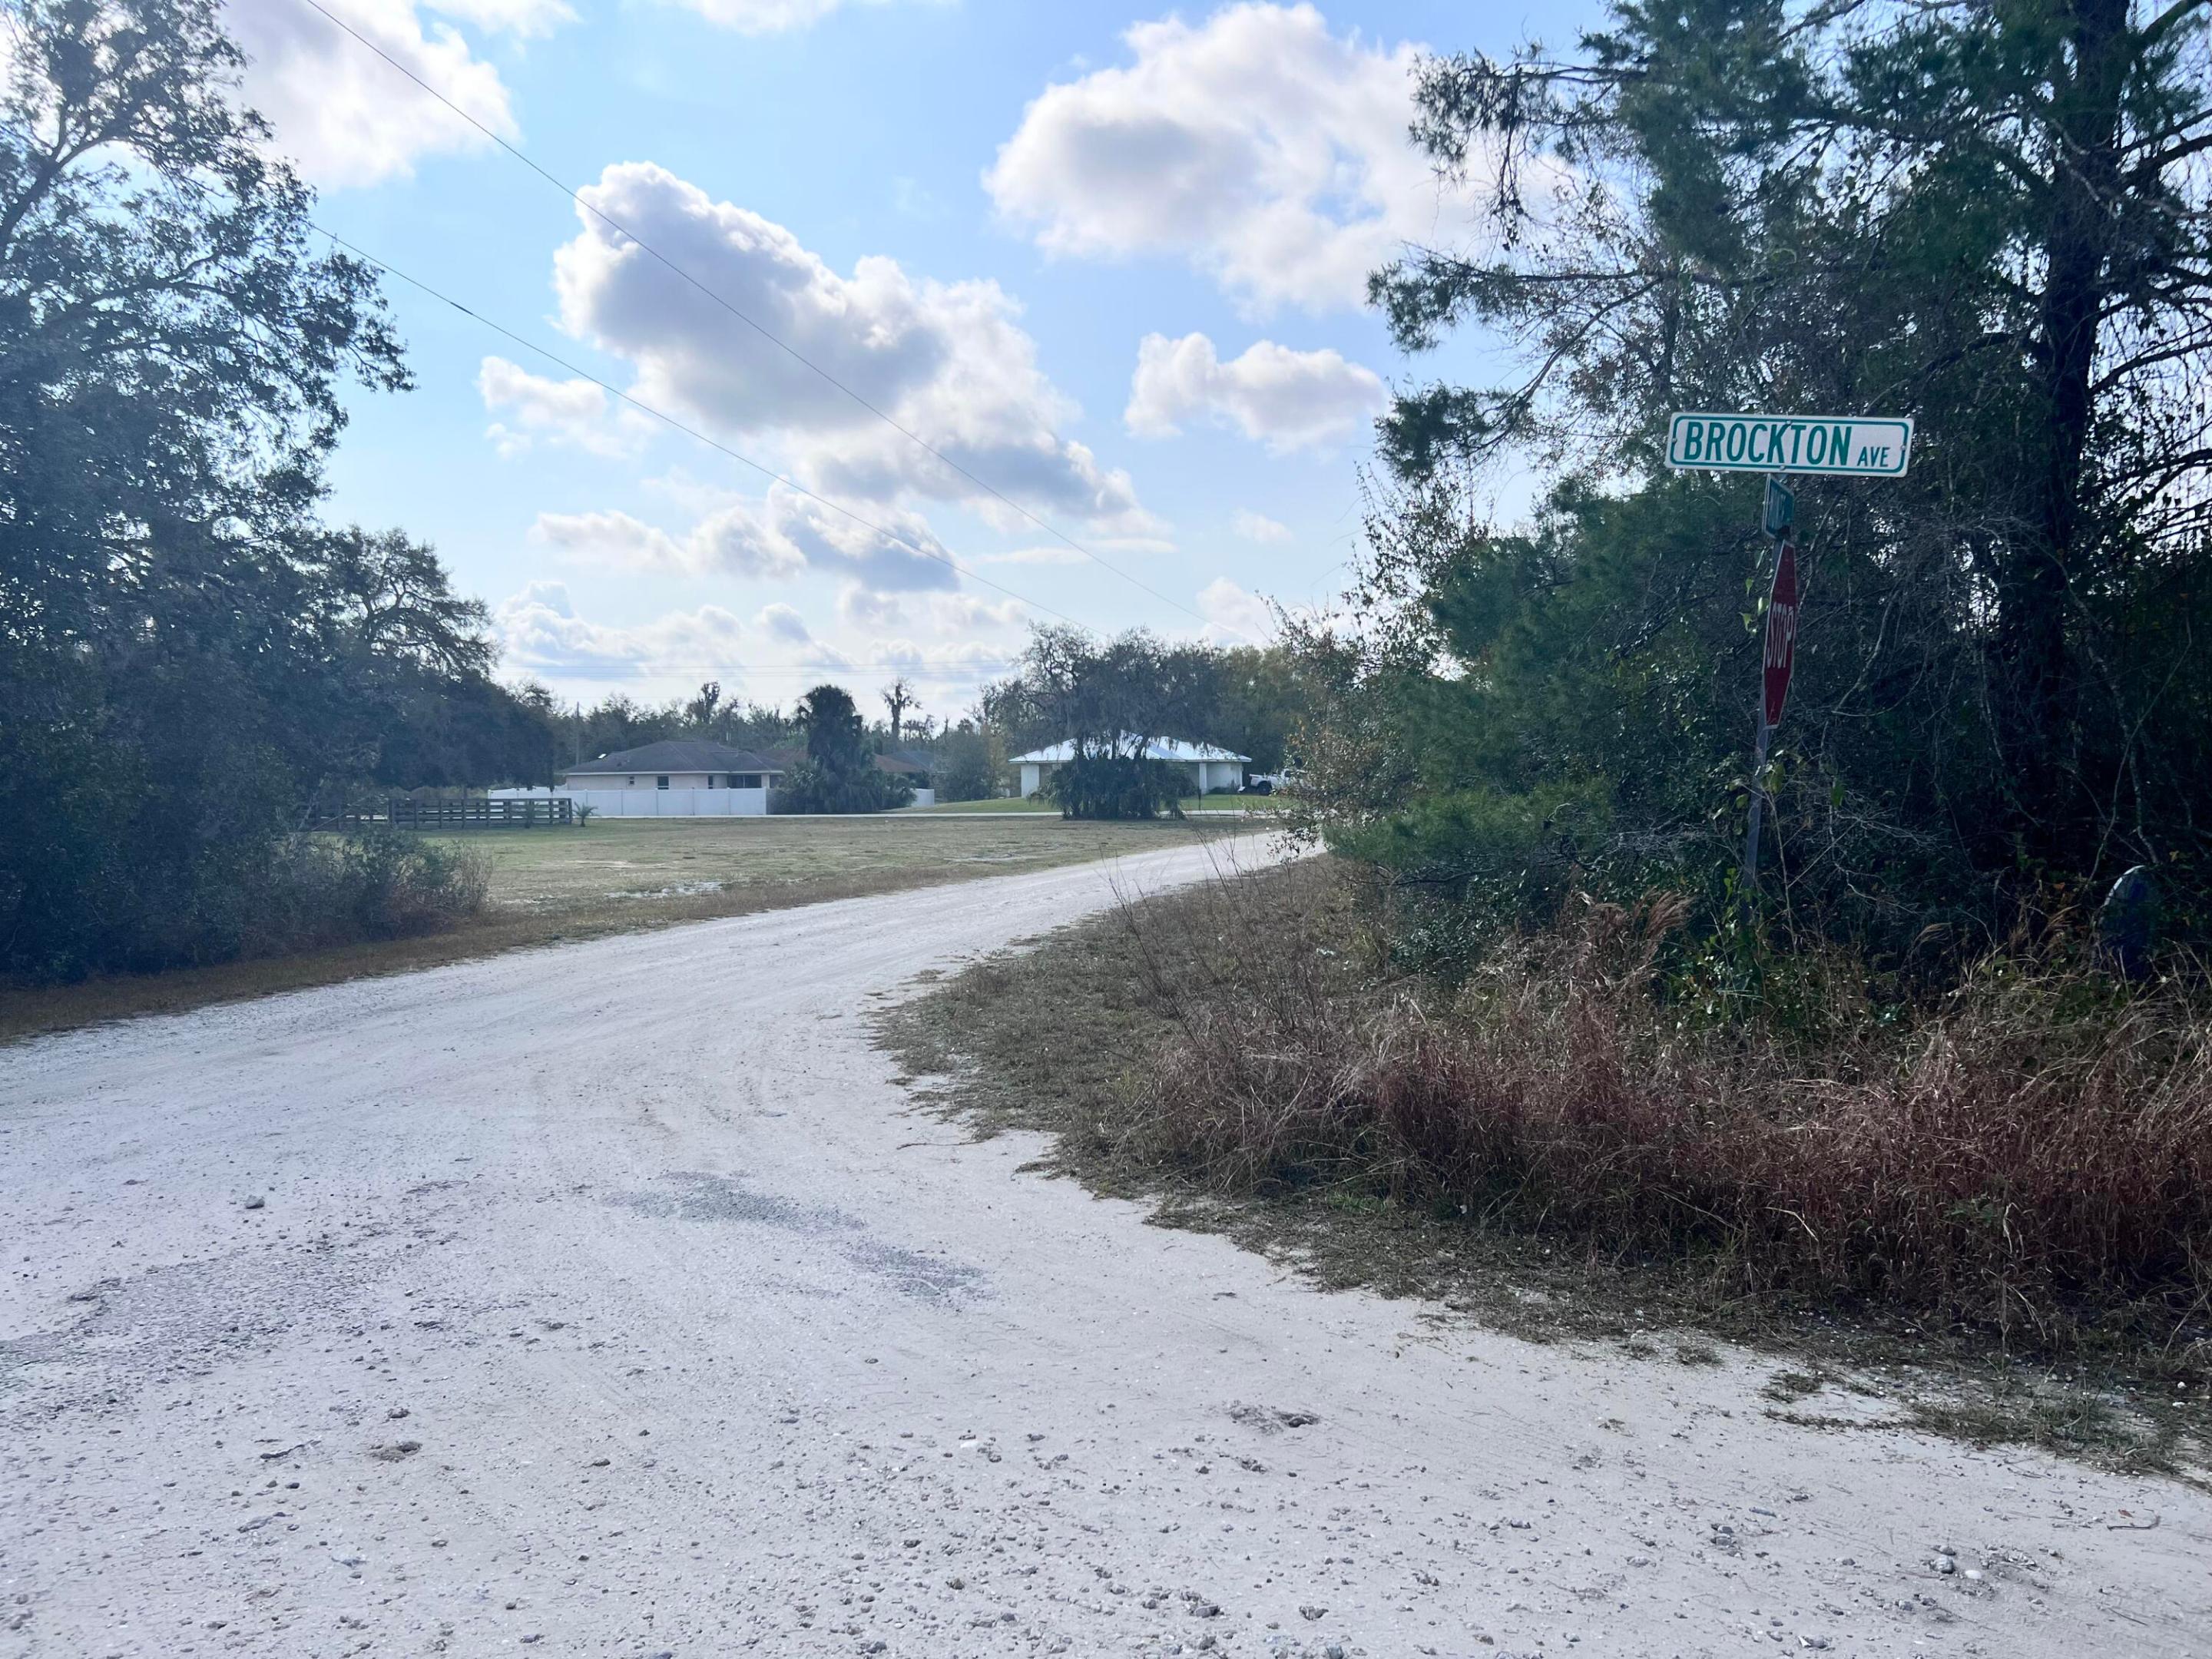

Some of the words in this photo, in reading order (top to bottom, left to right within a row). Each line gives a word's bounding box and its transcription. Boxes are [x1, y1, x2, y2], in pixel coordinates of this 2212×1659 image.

[1684, 422, 1852, 465] BROCKTON
[1856, 446, 1890, 467] AVE
[1767, 601, 1793, 668] STOP
